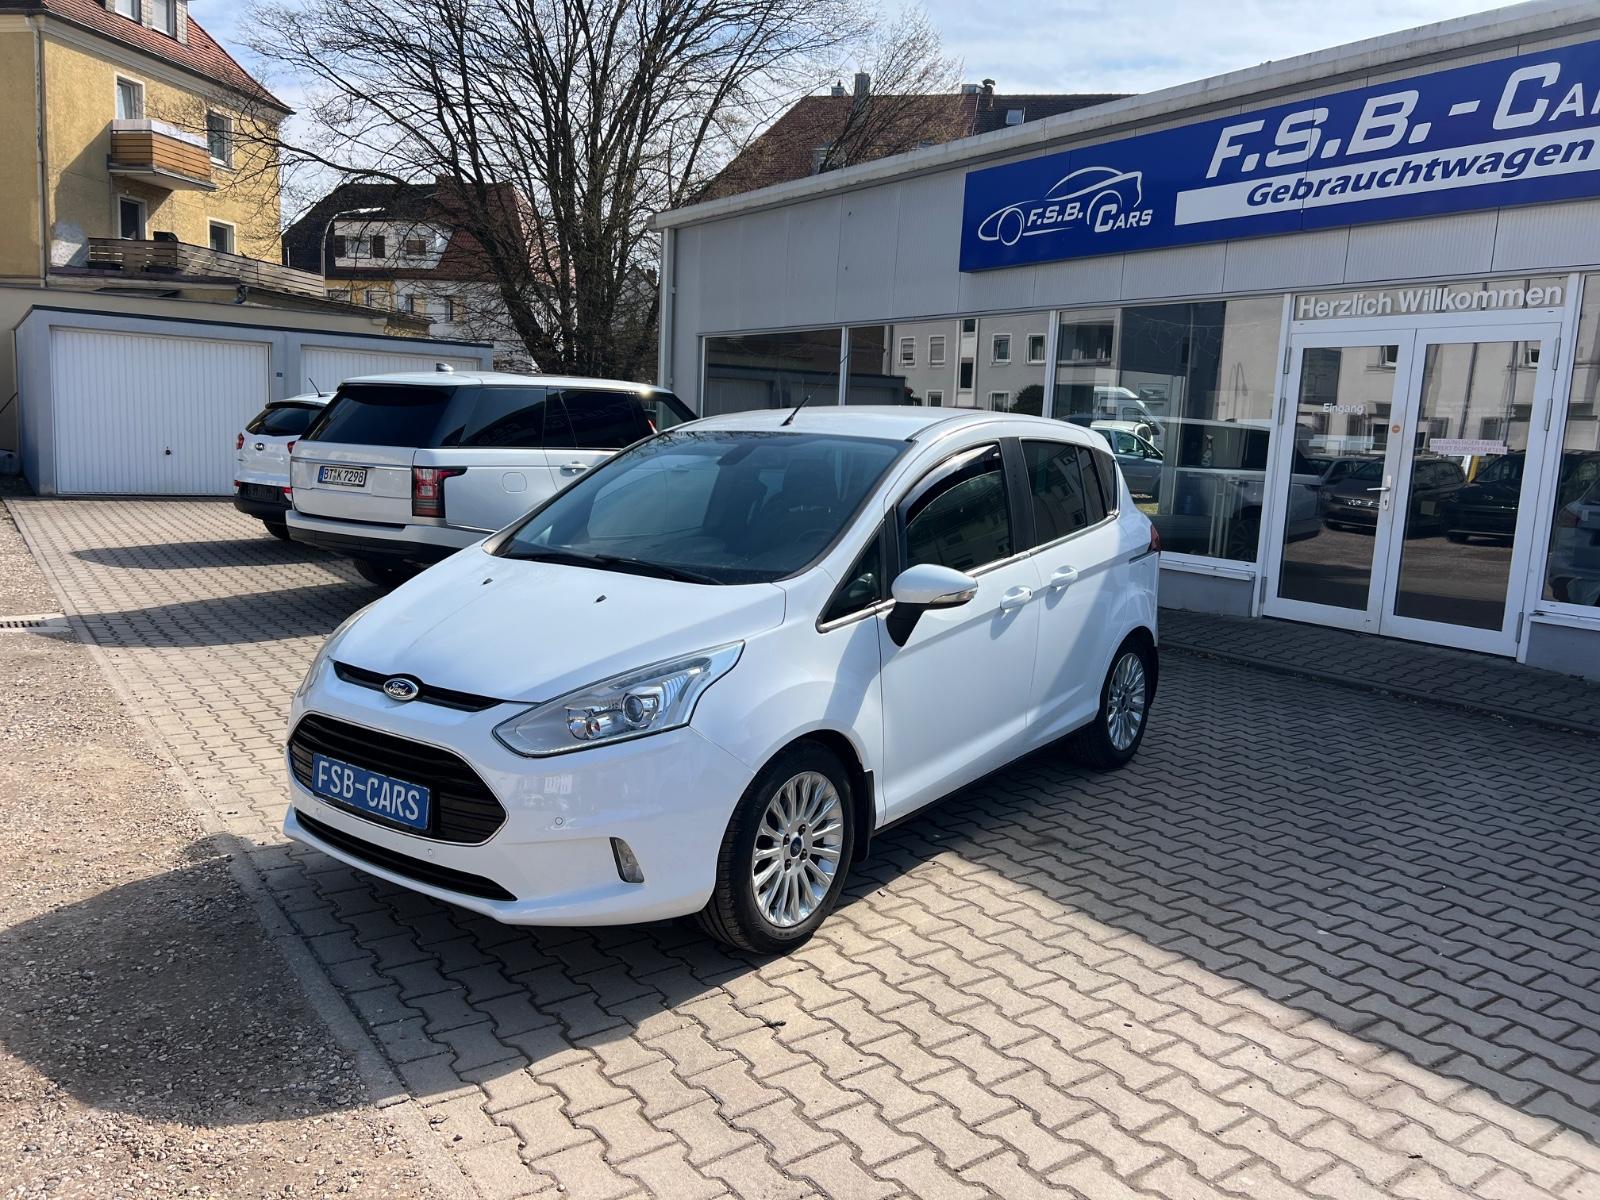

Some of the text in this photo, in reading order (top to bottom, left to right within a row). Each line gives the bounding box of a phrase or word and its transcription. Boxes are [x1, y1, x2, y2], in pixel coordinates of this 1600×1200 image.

[1246, 139, 1595, 207] Gebrauchtwagen
[1027, 202, 1084, 227] F.S.B.
[1298, 285, 1562, 319] Herzlich Willkommen
[1322, 402, 1365, 415] Eingang
[324, 468, 365, 483] BT K 7298
[388, 682, 409, 696] Ford
[317, 760, 420, 821] FSB-CARS
